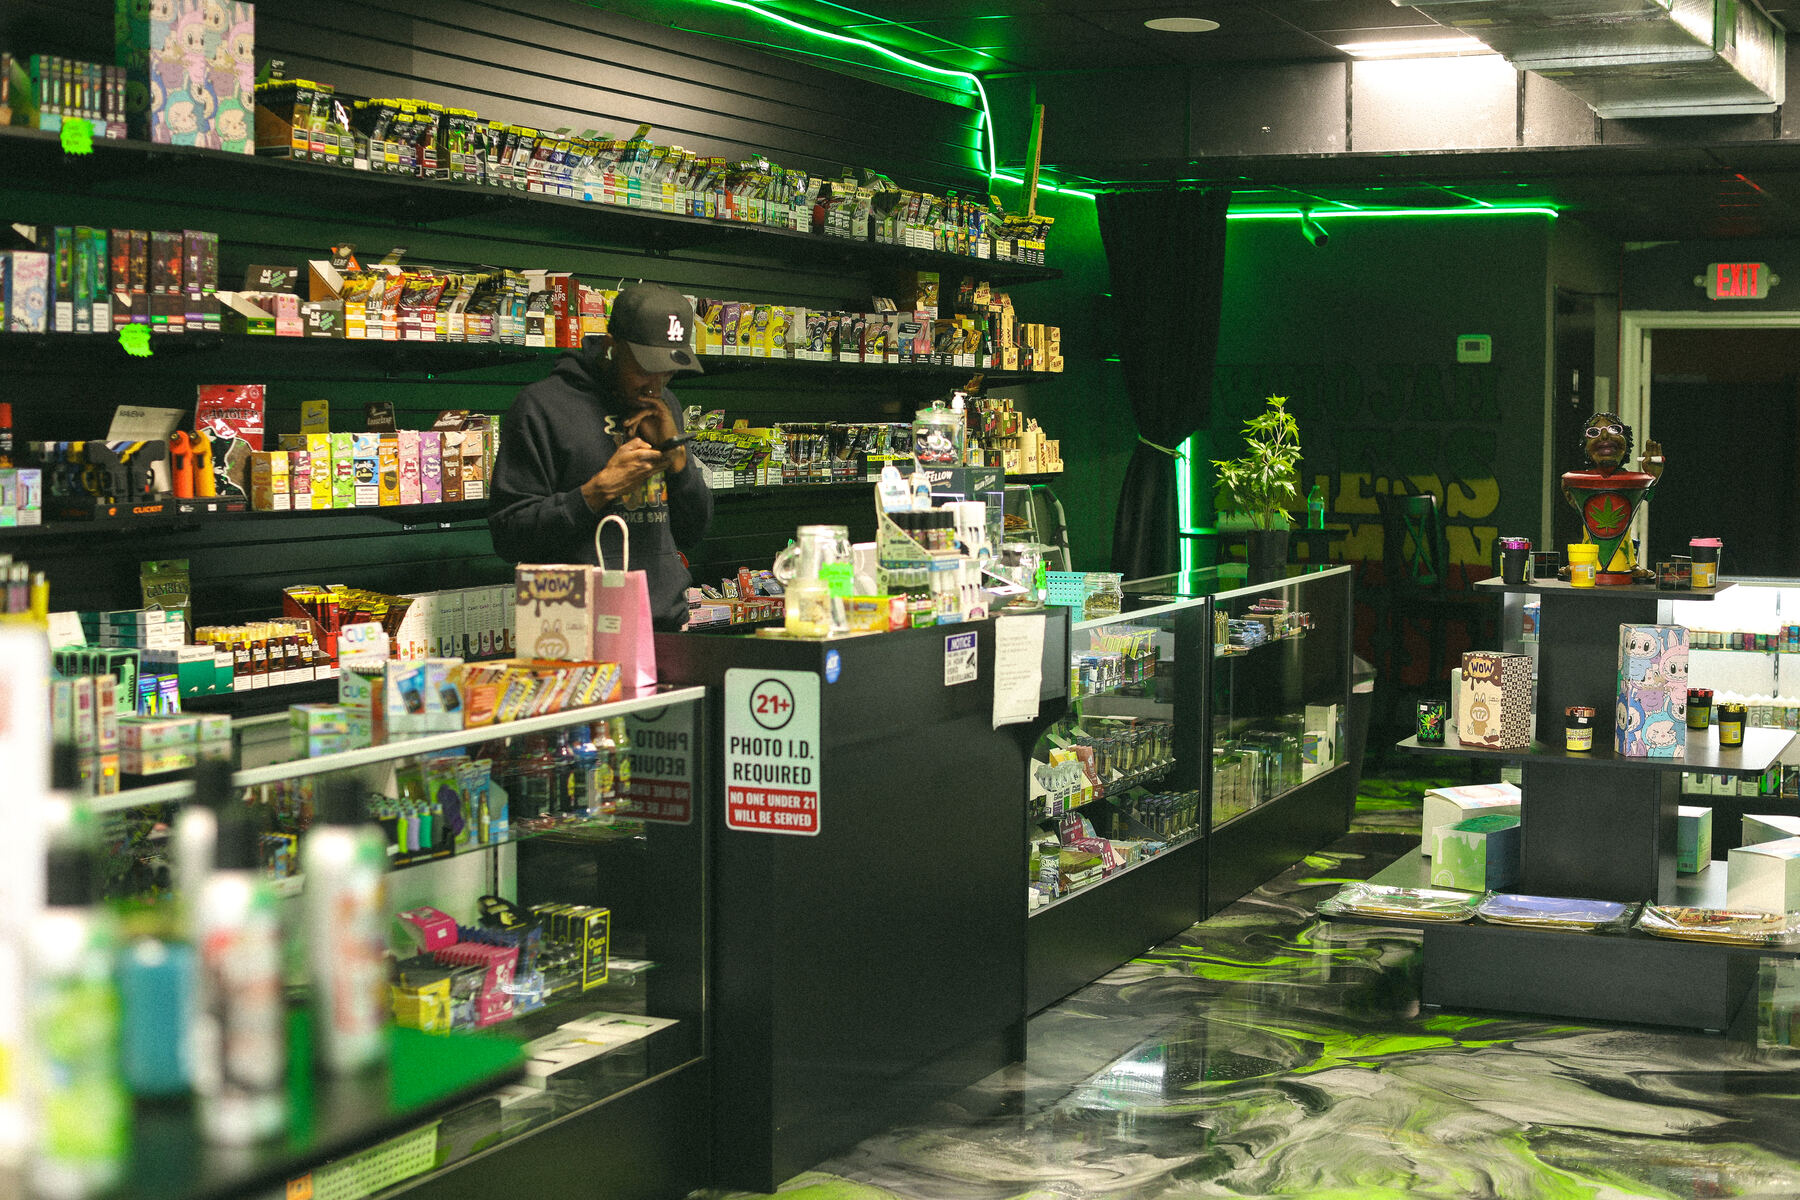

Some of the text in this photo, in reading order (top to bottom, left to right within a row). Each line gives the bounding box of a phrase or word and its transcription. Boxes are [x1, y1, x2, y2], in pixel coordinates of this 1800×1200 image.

[1716, 264, 1760, 296] EXIT
[667, 314, 685, 342] LA
[1369, 364, 1503, 422] JAH
[925, 471, 953, 482] FELLOW
[535, 577, 573, 593] WOW
[345, 625, 375, 643] cue
[950, 635, 972, 651] NOTICE
[1471, 662, 1495, 674] WOW
[756, 694, 791, 714] 21+
[730, 736, 814, 759] PHOTO I.D.
[733, 762, 812, 785] REQUIRED
[730, 791, 816, 810] NO ONE UNDER 21
[734, 809, 812, 827] WILL BE SERVED
